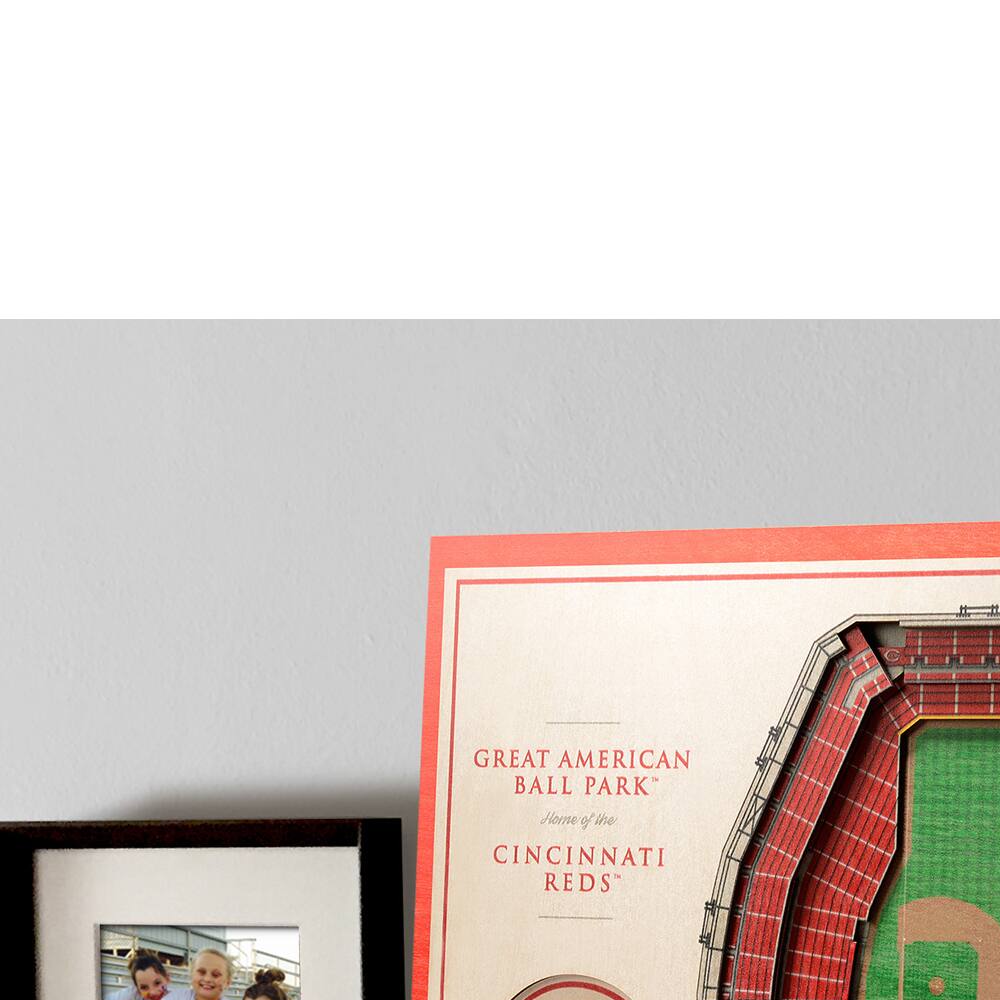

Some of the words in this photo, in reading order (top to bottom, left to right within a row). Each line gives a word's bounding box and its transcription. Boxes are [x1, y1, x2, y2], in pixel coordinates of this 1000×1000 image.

[473, 749, 549, 768] GREAT
[558, 750, 690, 769] AMERICAN
[514, 776, 572, 795] BALL
[540, 811, 578, 825] Home
[580, 812, 595, 830] of
[594, 812, 618, 826] the
[493, 845, 664, 867] CINCINNATI
